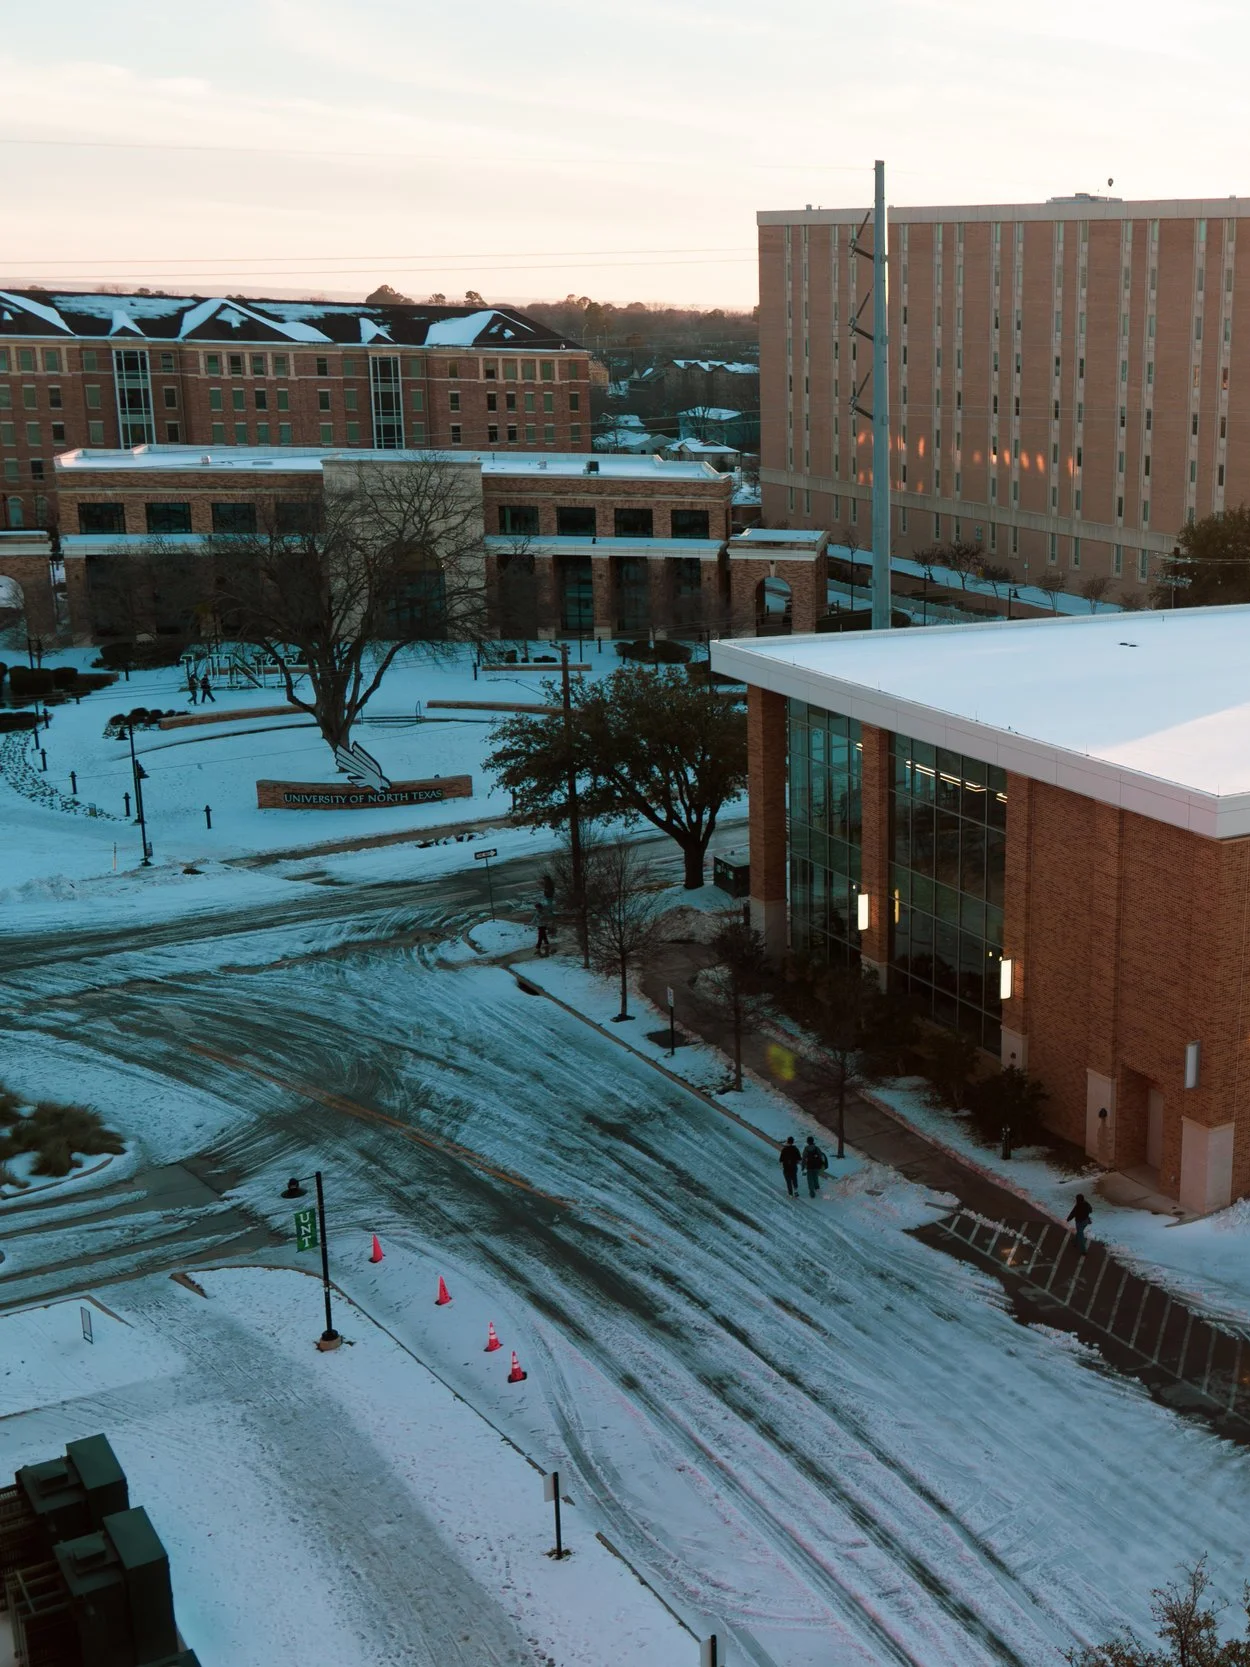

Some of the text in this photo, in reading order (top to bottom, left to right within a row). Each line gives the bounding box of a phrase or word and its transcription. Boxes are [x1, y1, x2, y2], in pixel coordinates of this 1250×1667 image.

[284, 790, 442, 804] UNIVERSITY OF NORTH TEXAS
[299, 1211, 312, 1248] UNT
